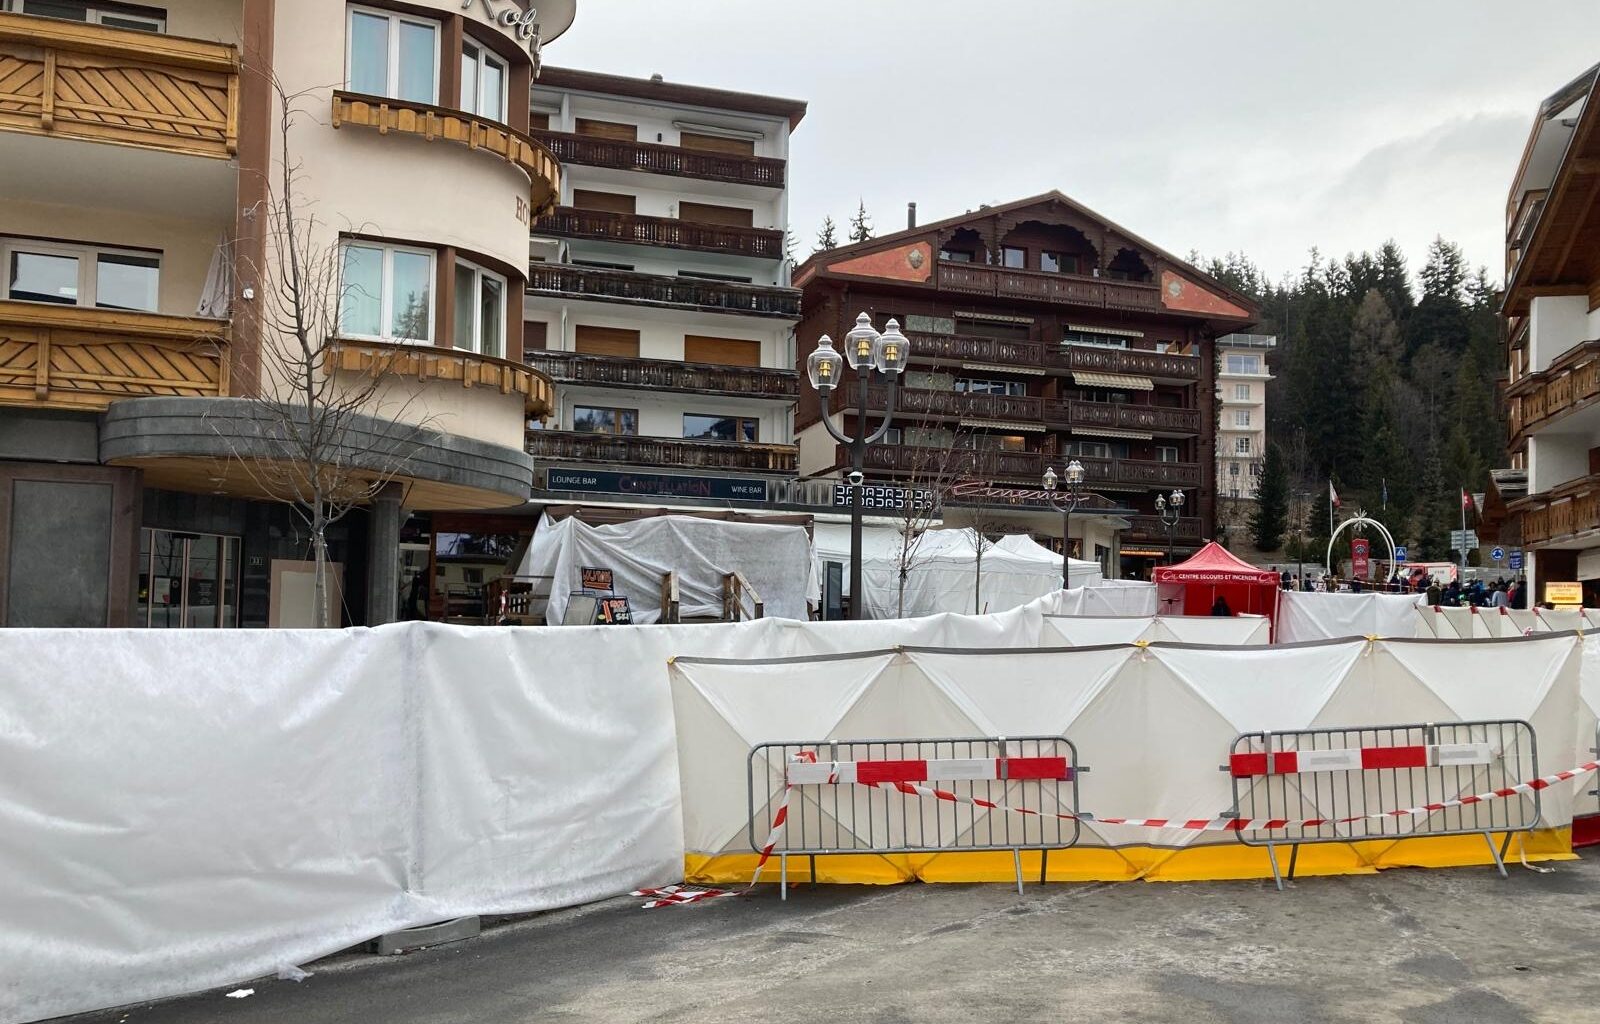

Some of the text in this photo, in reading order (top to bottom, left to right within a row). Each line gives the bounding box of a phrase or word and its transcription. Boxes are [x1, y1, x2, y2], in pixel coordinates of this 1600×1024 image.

[552, 475, 597, 486] LOUNGE BAR
[731, 485, 762, 495] WINE BAR
